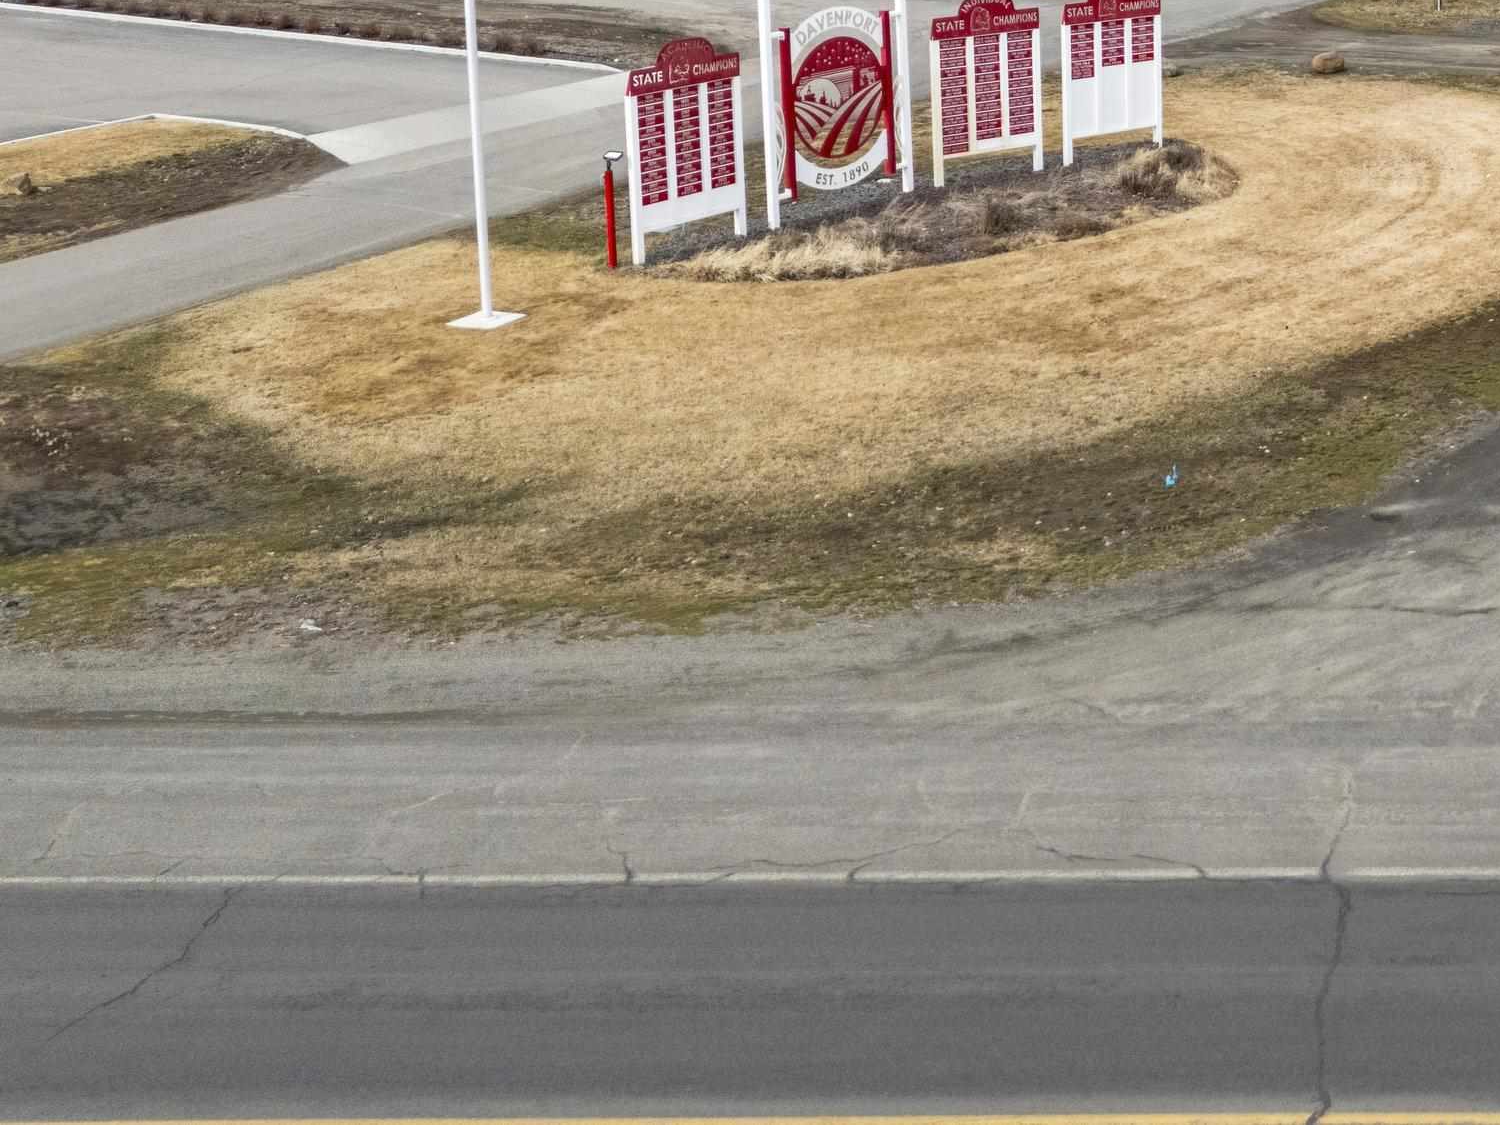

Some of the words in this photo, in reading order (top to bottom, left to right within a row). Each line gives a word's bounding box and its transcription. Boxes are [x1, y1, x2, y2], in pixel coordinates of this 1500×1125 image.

[935, 19, 965, 33] STATE
[993, 12, 1038, 26] CHAMPIONS
[1066, 6, 1094, 18] STATE
[795, 10, 879, 45] DAVENPORT
[632, 70, 664, 87] STATE
[692, 57, 737, 76] CHAMPIONS
[816, 172, 838, 186] EST.
[843, 161, 869, 184] 1890
